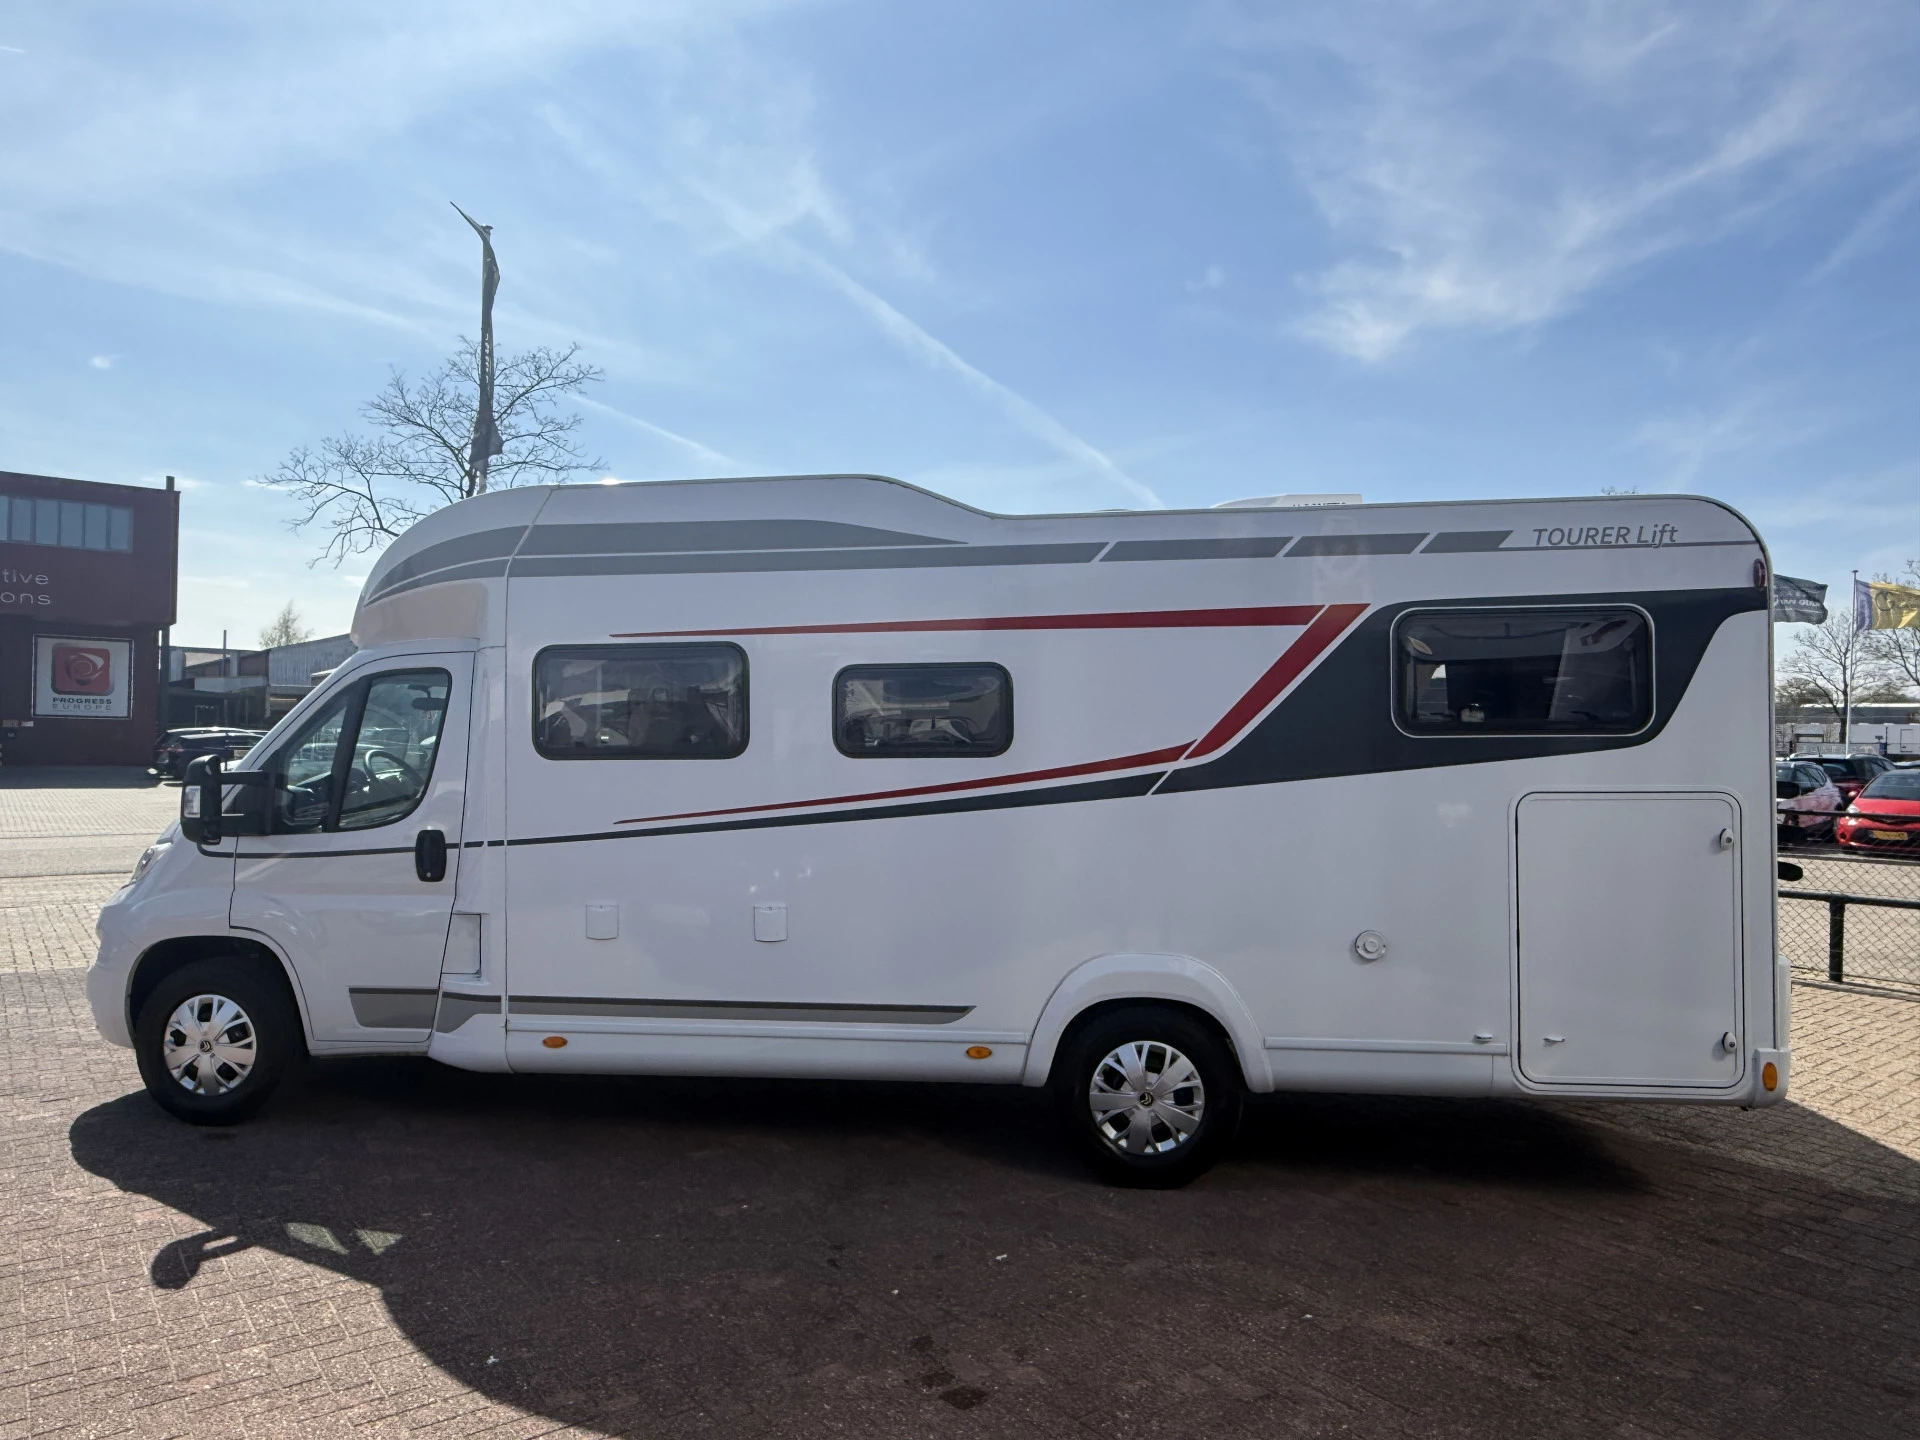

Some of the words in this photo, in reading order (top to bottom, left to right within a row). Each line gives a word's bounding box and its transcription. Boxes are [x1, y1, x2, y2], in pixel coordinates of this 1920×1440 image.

[1533, 526, 1630, 546] TOURER
[1636, 523, 1678, 549] Lift
[2, 569, 49, 585] tive
[0, 591, 51, 605] ons
[52, 697, 112, 705] PROGRESS
[52, 703, 112, 711] EUROPE
